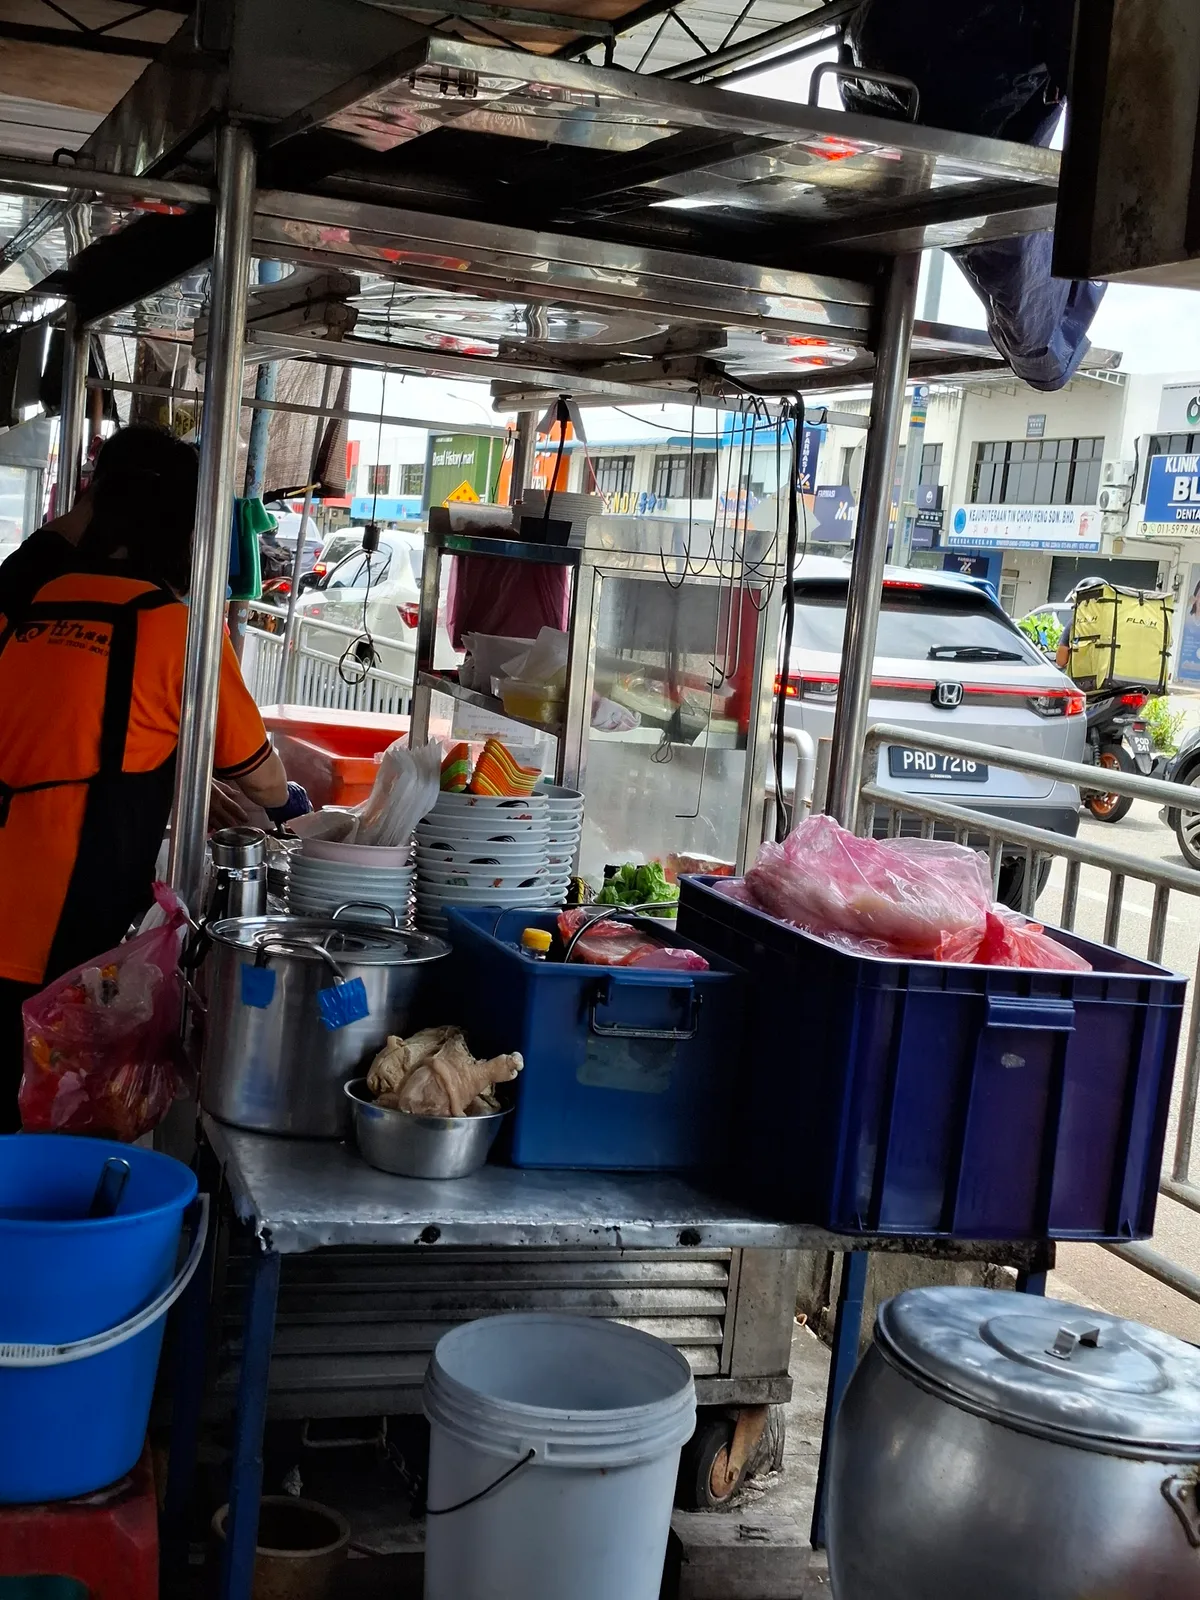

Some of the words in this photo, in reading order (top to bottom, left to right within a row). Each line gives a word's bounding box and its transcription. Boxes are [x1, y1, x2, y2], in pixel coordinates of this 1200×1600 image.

[432, 450, 446, 466] Bread
[802, 431, 811, 474] FARMASI
[1165, 456, 1200, 473] KLINIK
[1156, 523, 1189, 534] 011-5979
[1137, 743, 1150, 751] 241
[903, 751, 937, 771] PRD
